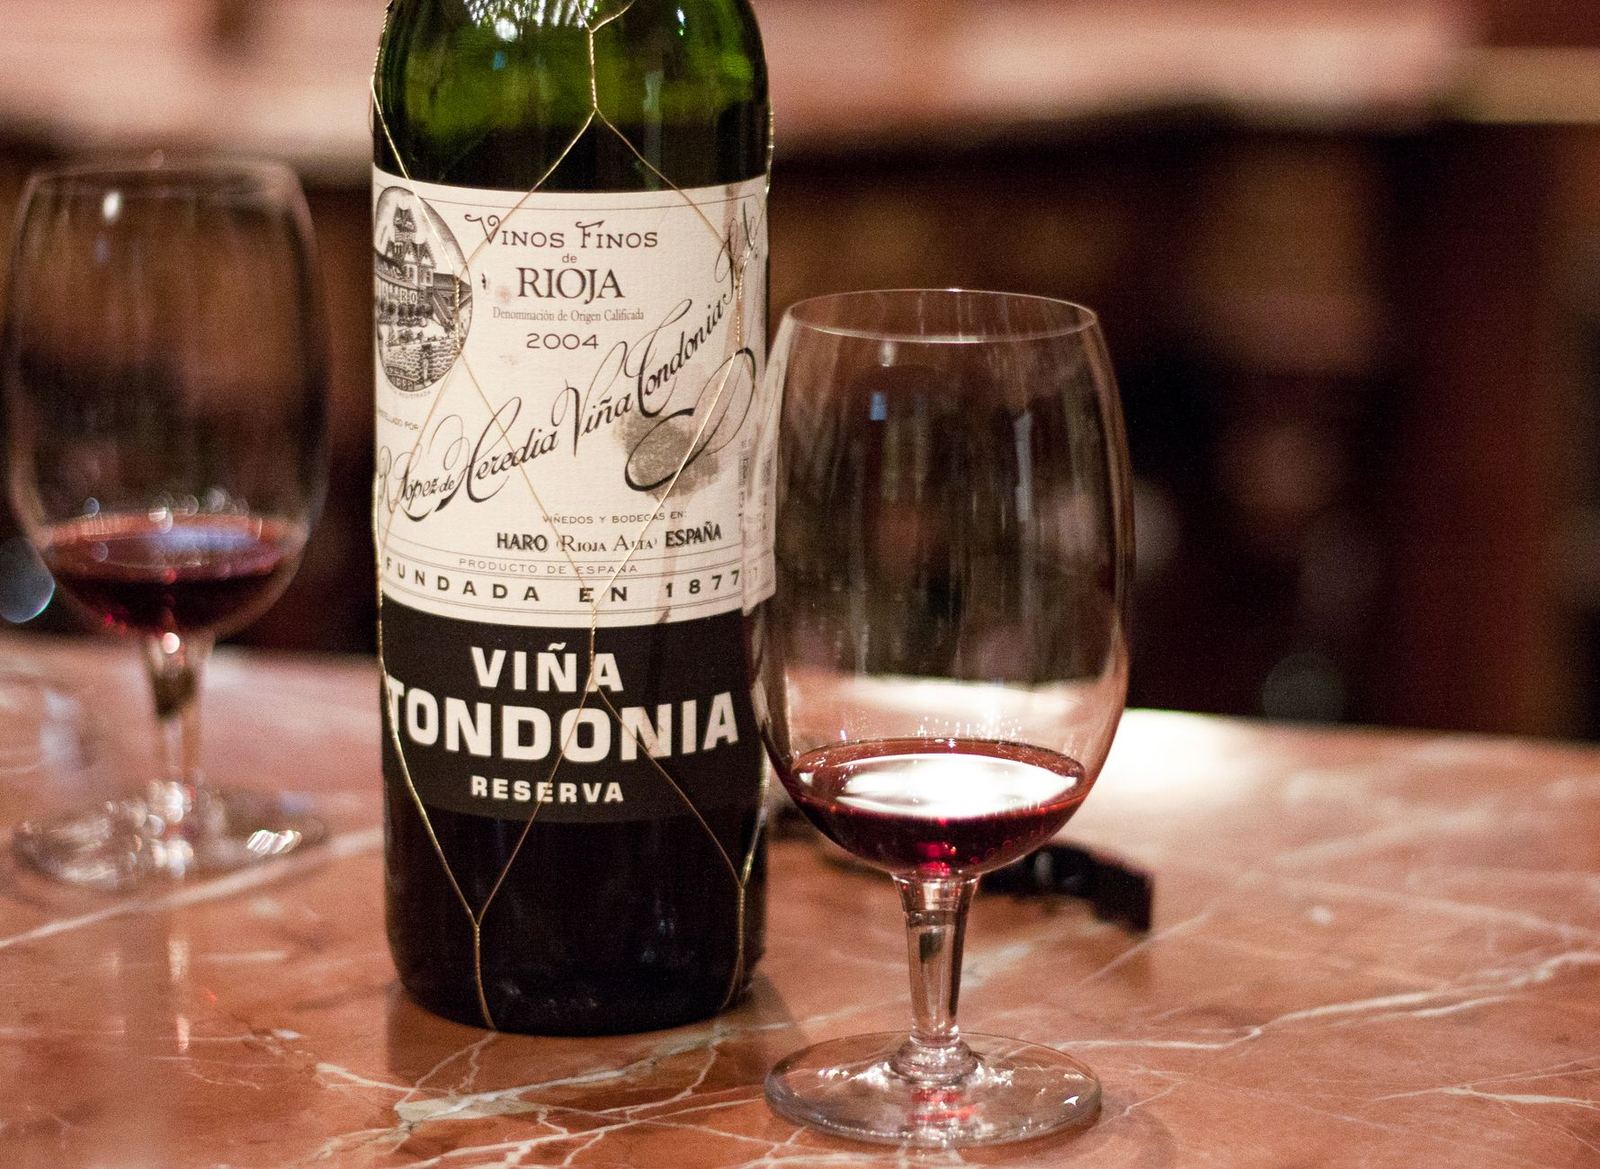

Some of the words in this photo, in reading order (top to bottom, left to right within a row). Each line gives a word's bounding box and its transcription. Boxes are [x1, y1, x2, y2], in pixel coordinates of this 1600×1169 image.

[464, 214, 565, 249] VINOS
[575, 220, 659, 249] FINOS
[561, 253, 578, 264] de
[516, 267, 626, 305] RIOJA
[492, 306, 555, 321] Denominación
[557, 309, 568, 321] de
[570, 309, 602, 324] Origen
[603, 307, 645, 321] Calificada
[526, 332, 600, 350] 2004
[552, 341, 634, 457] Viña
[542, 512, 594, 525] VIÑEDOS
[599, 516, 606, 524] Y
[612, 512, 666, 524] BODEGAS
[496, 532, 549, 552] HARO
[665, 520, 722, 549] ESPAÑA
[386, 556, 540, 602] FUNDADA
[579, 585, 628, 602] EN
[665, 569, 741, 598] 1877
[459, 558, 538, 574] PRODUCTO
[546, 564, 567, 575] DE
[471, 641, 625, 692] VIÑA
[386, 673, 740, 762] TONDONIA
[471, 774, 625, 803] RESERVA
